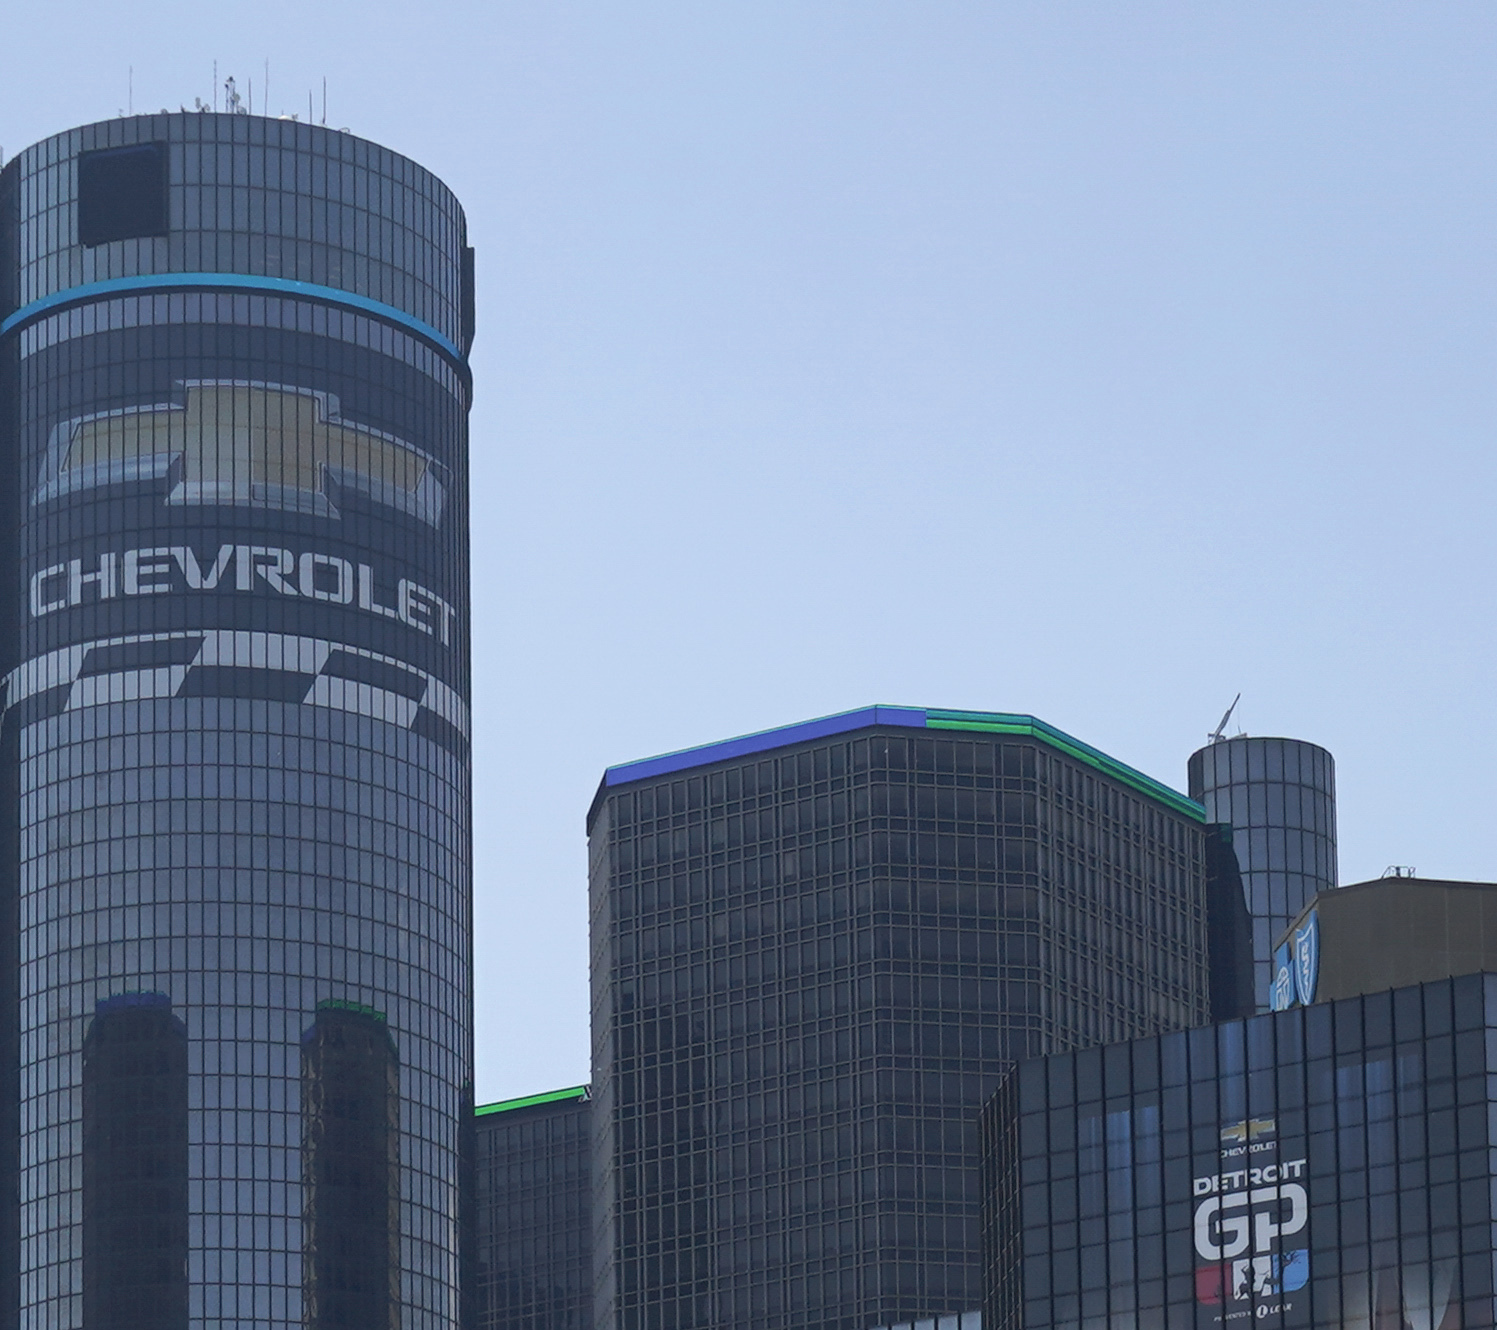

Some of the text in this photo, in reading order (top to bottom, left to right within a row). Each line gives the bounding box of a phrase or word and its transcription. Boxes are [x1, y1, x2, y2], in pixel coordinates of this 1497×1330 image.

[30, 545, 456, 648] CHEVROLET
[1193, 1159, 1306, 1196] DETROIT
[1194, 1183, 1308, 1261] GP
